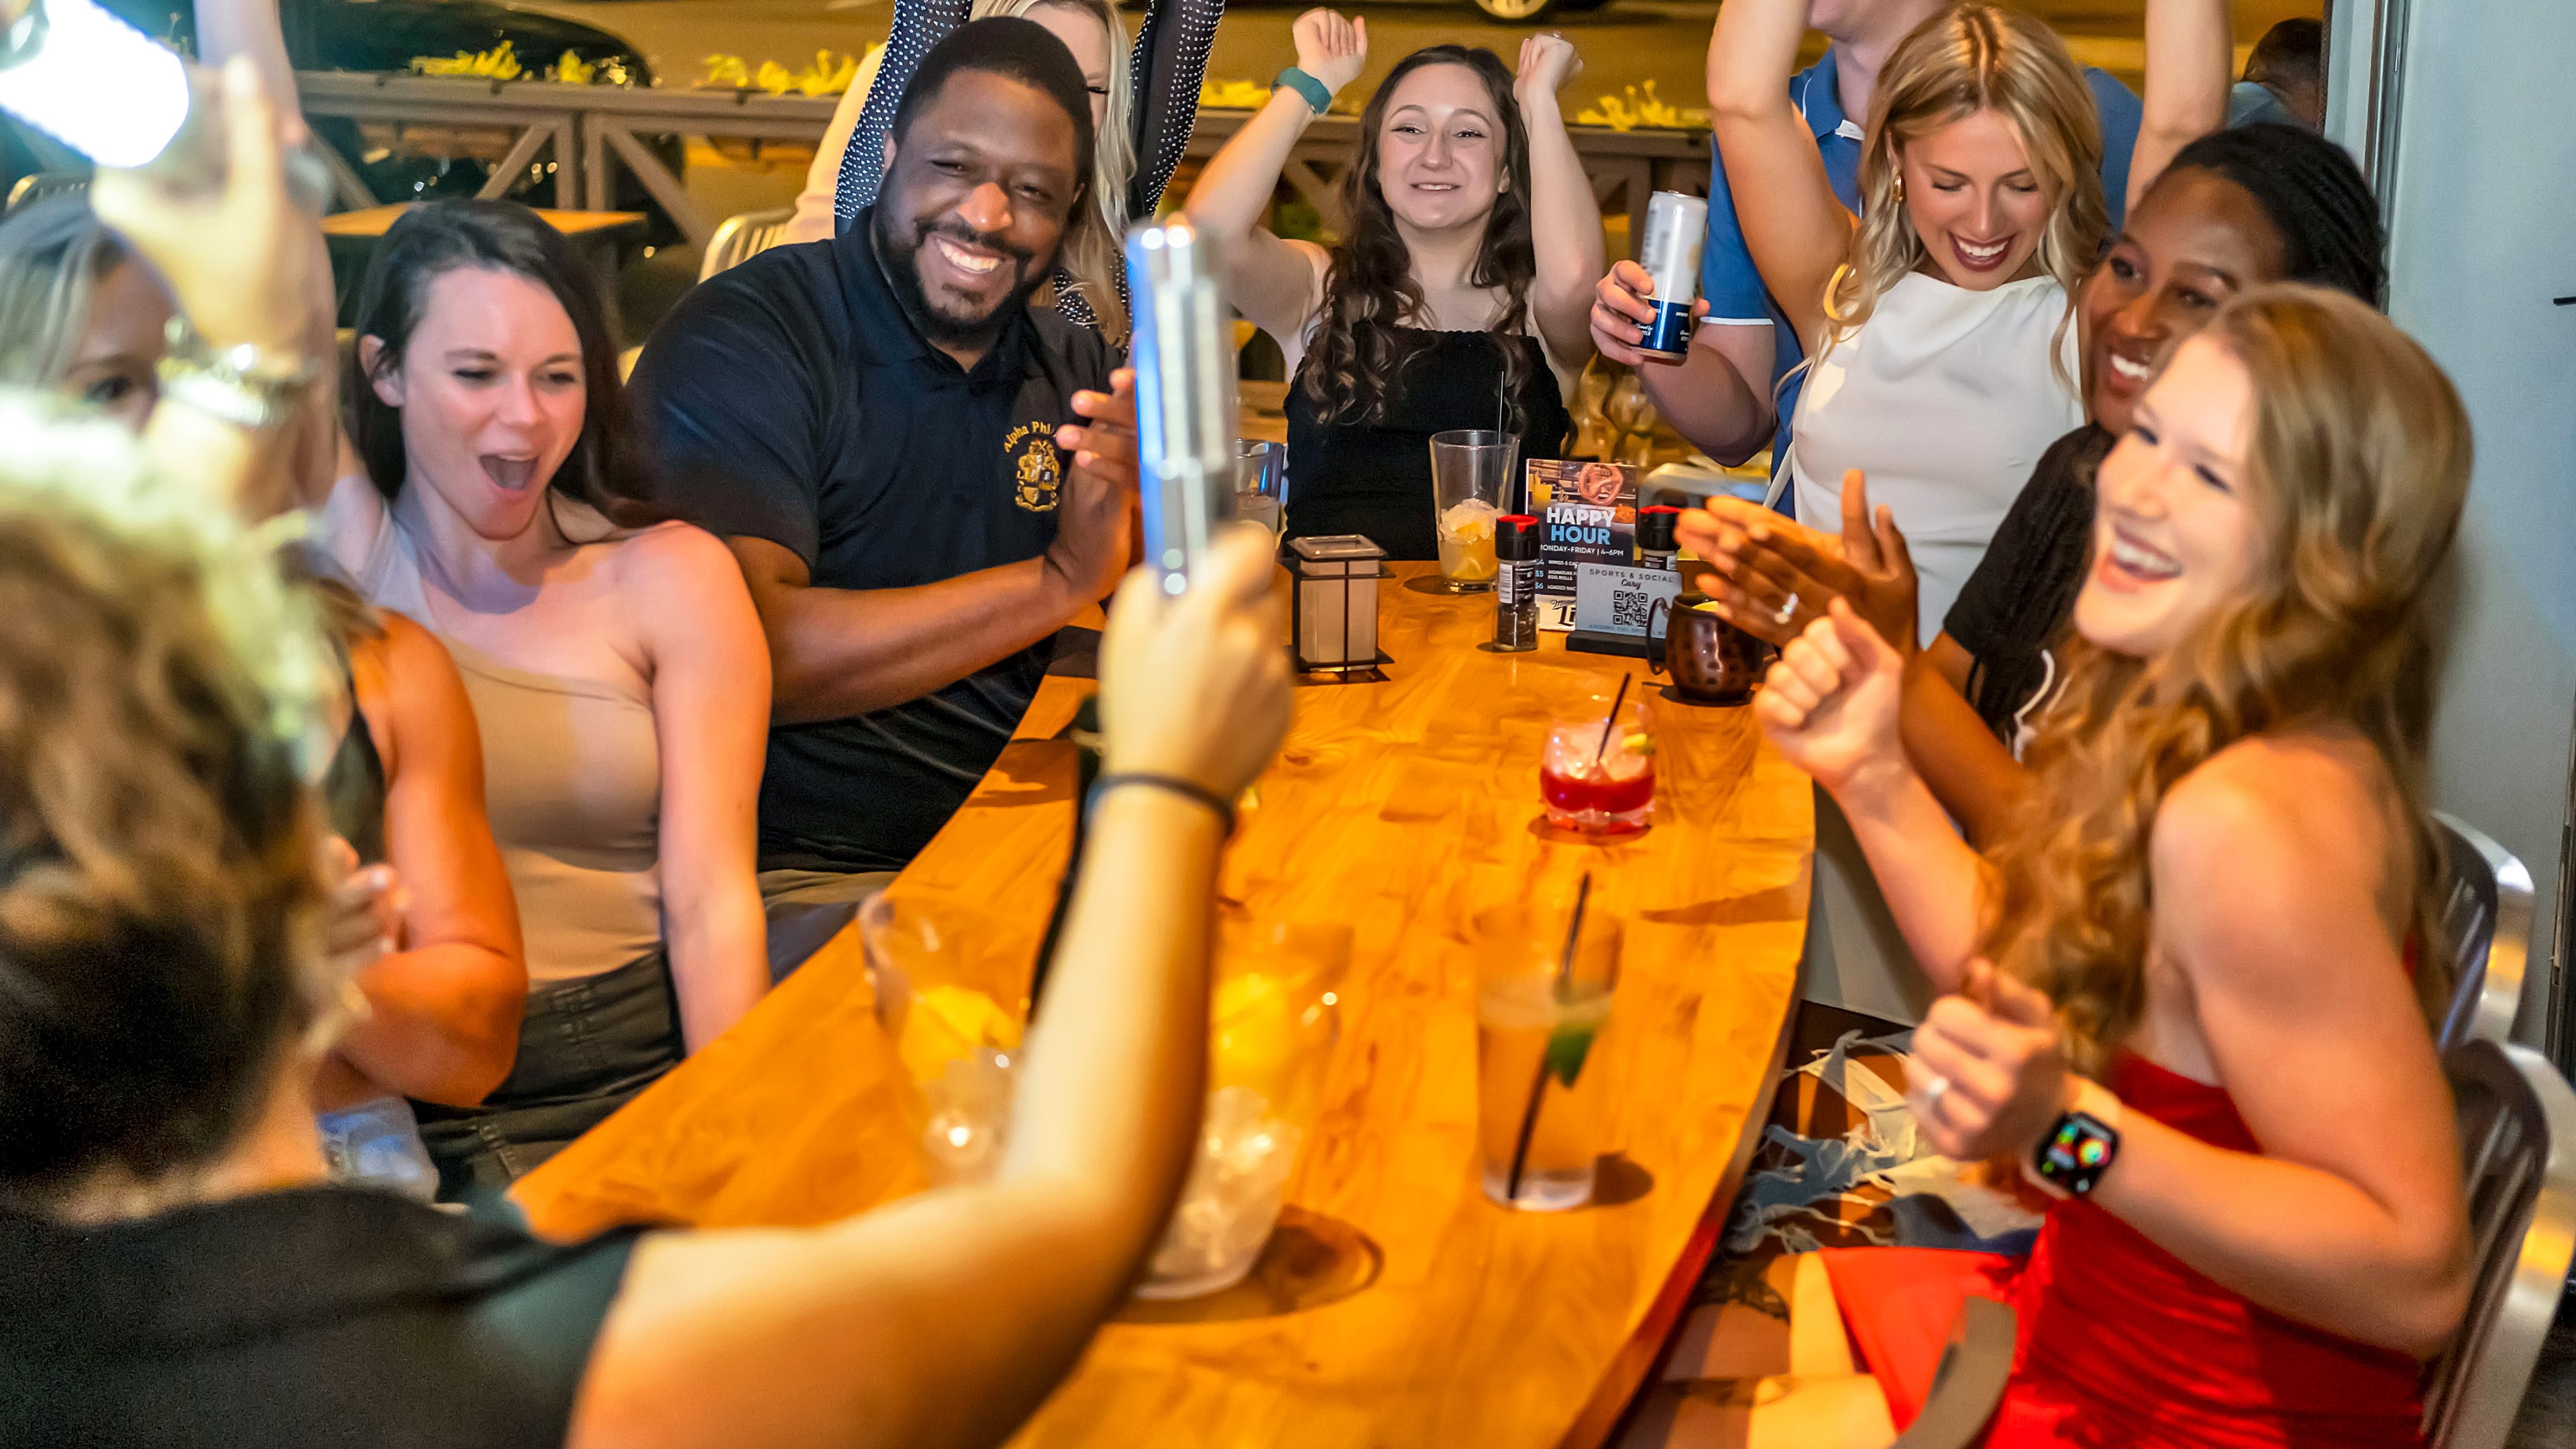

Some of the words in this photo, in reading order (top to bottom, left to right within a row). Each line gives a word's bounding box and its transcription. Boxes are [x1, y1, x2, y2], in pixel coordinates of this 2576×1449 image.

[1004, 425, 1030, 453] Alpha
[1546, 506, 1616, 527] HAPPY
[1551, 525, 1610, 545] HOUR
[1589, 568, 1625, 578] SPORTS
[1639, 574, 1674, 582] SOCIAL
[1621, 578, 1642, 590] Cary
